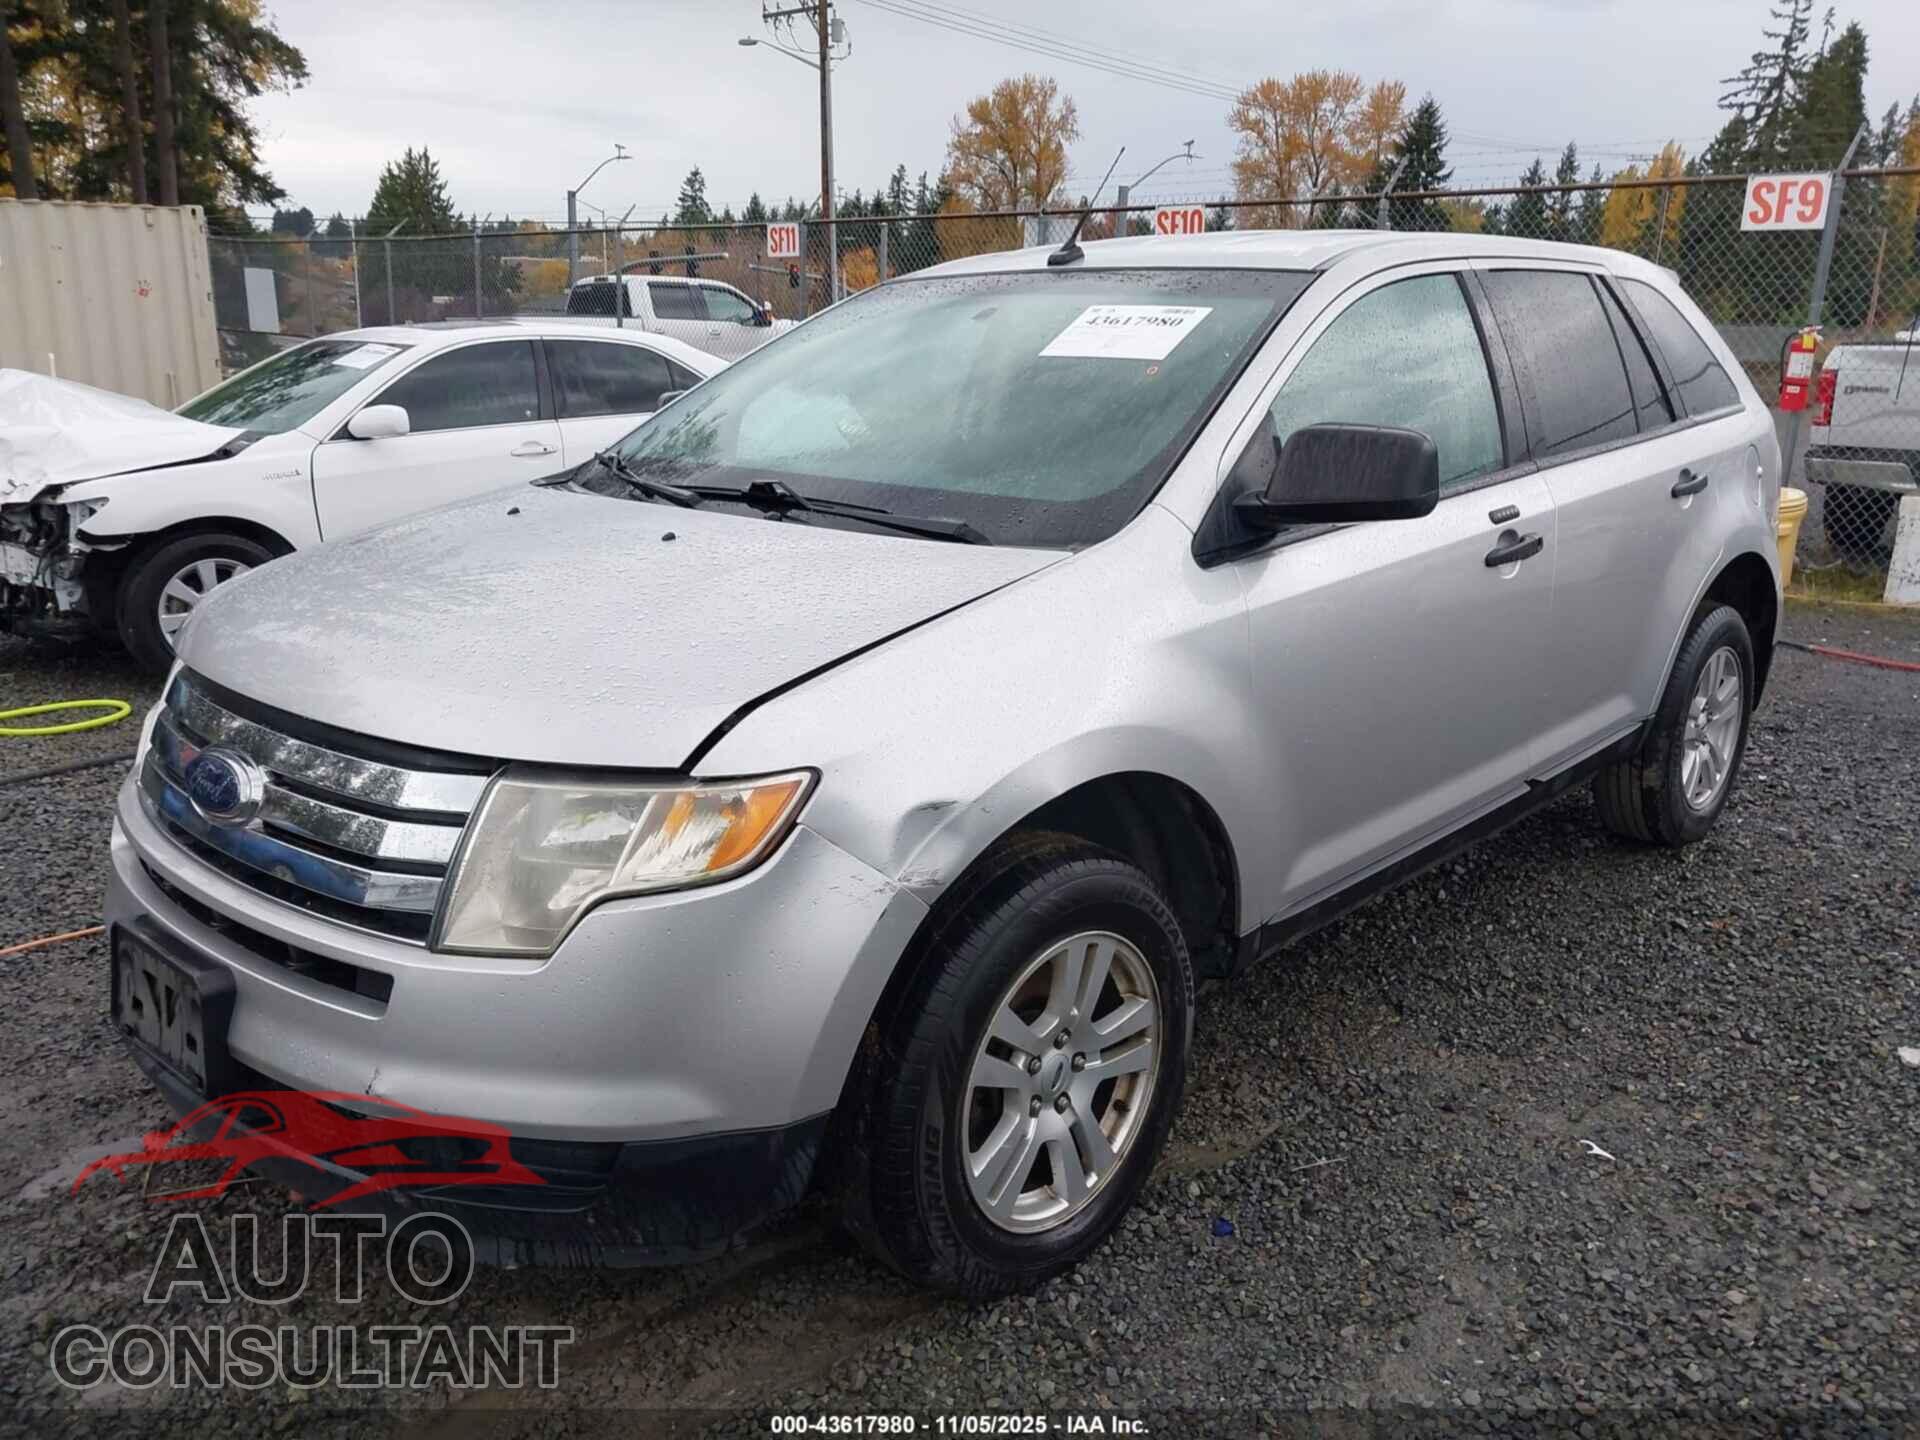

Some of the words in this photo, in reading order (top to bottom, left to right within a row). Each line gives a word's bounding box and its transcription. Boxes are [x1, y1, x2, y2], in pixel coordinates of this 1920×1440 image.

[1748, 179, 1824, 225] SF9
[1156, 208, 1204, 234] SF10
[769, 226, 796, 253] SF11
